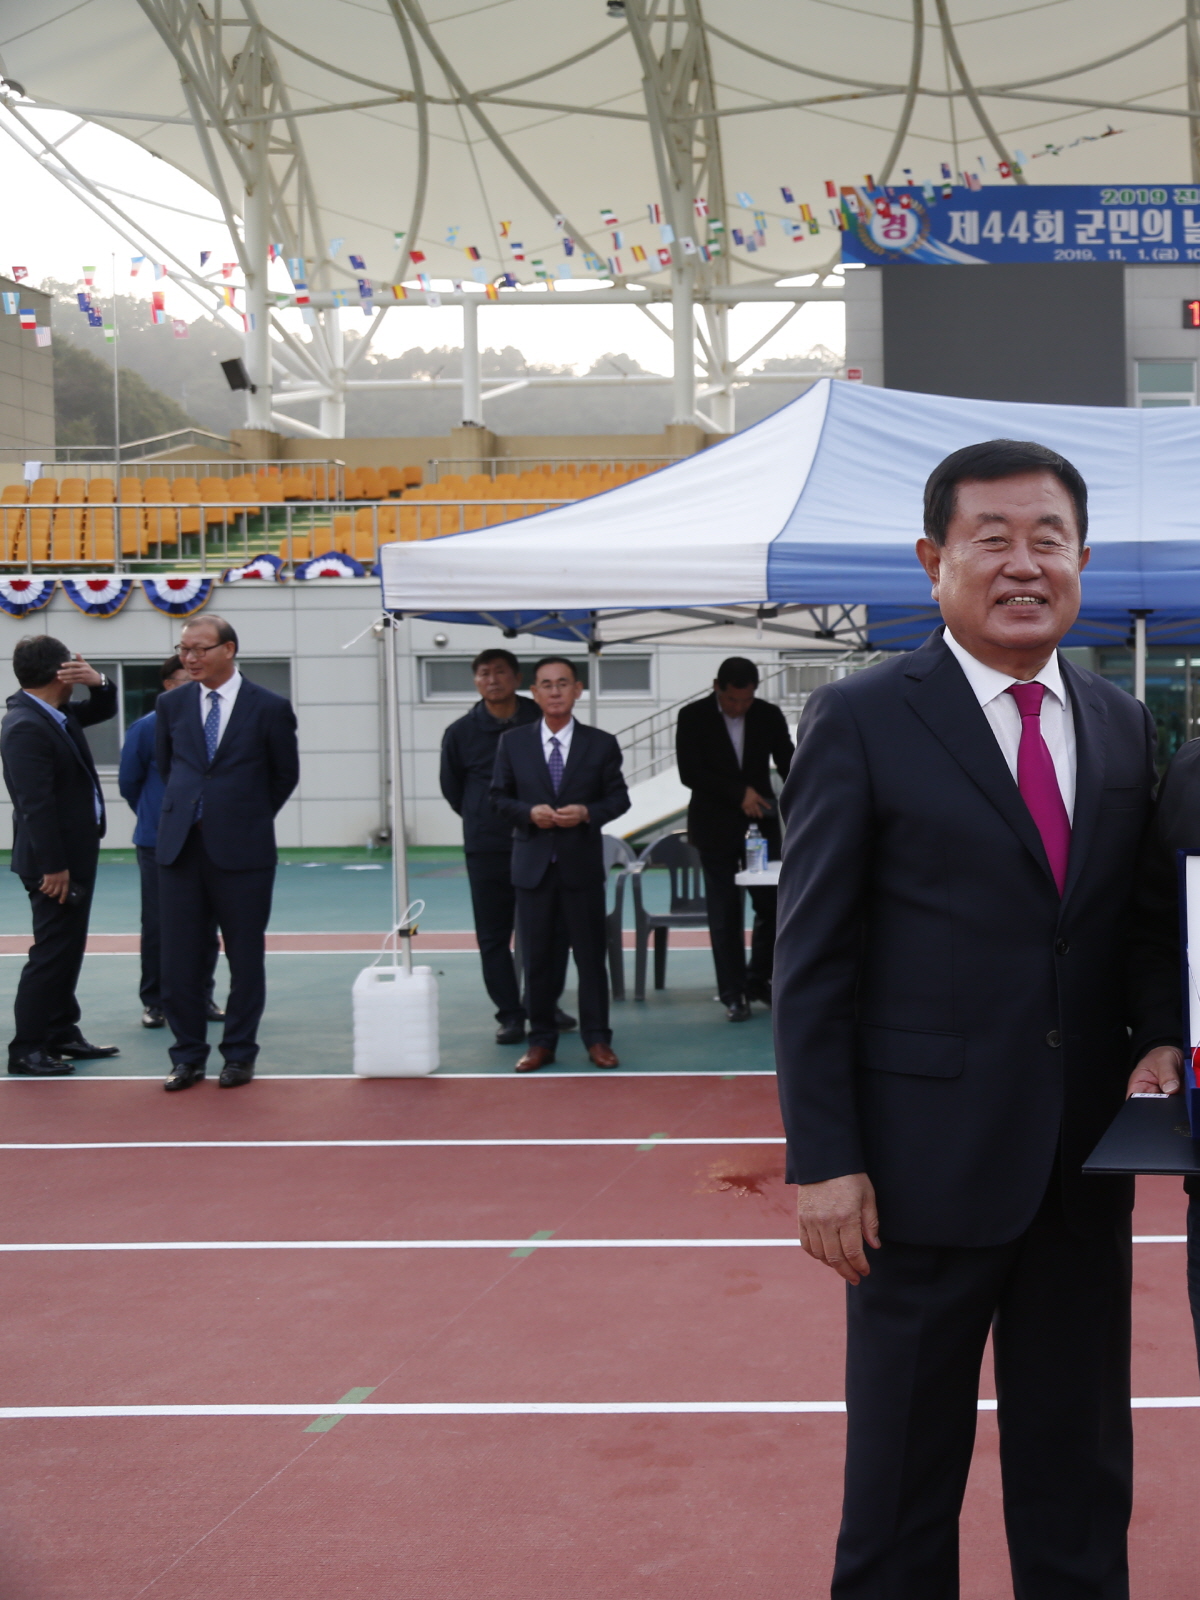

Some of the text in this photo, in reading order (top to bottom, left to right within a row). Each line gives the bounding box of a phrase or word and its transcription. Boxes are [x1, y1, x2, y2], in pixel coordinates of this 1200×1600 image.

[1100, 188, 1167, 205] 2019
[881, 213, 907, 240] 경
[947, 209, 1064, 244] 제44회
[1075, 209, 1172, 244] 군민의
[1053, 249, 1097, 261] 2019.
